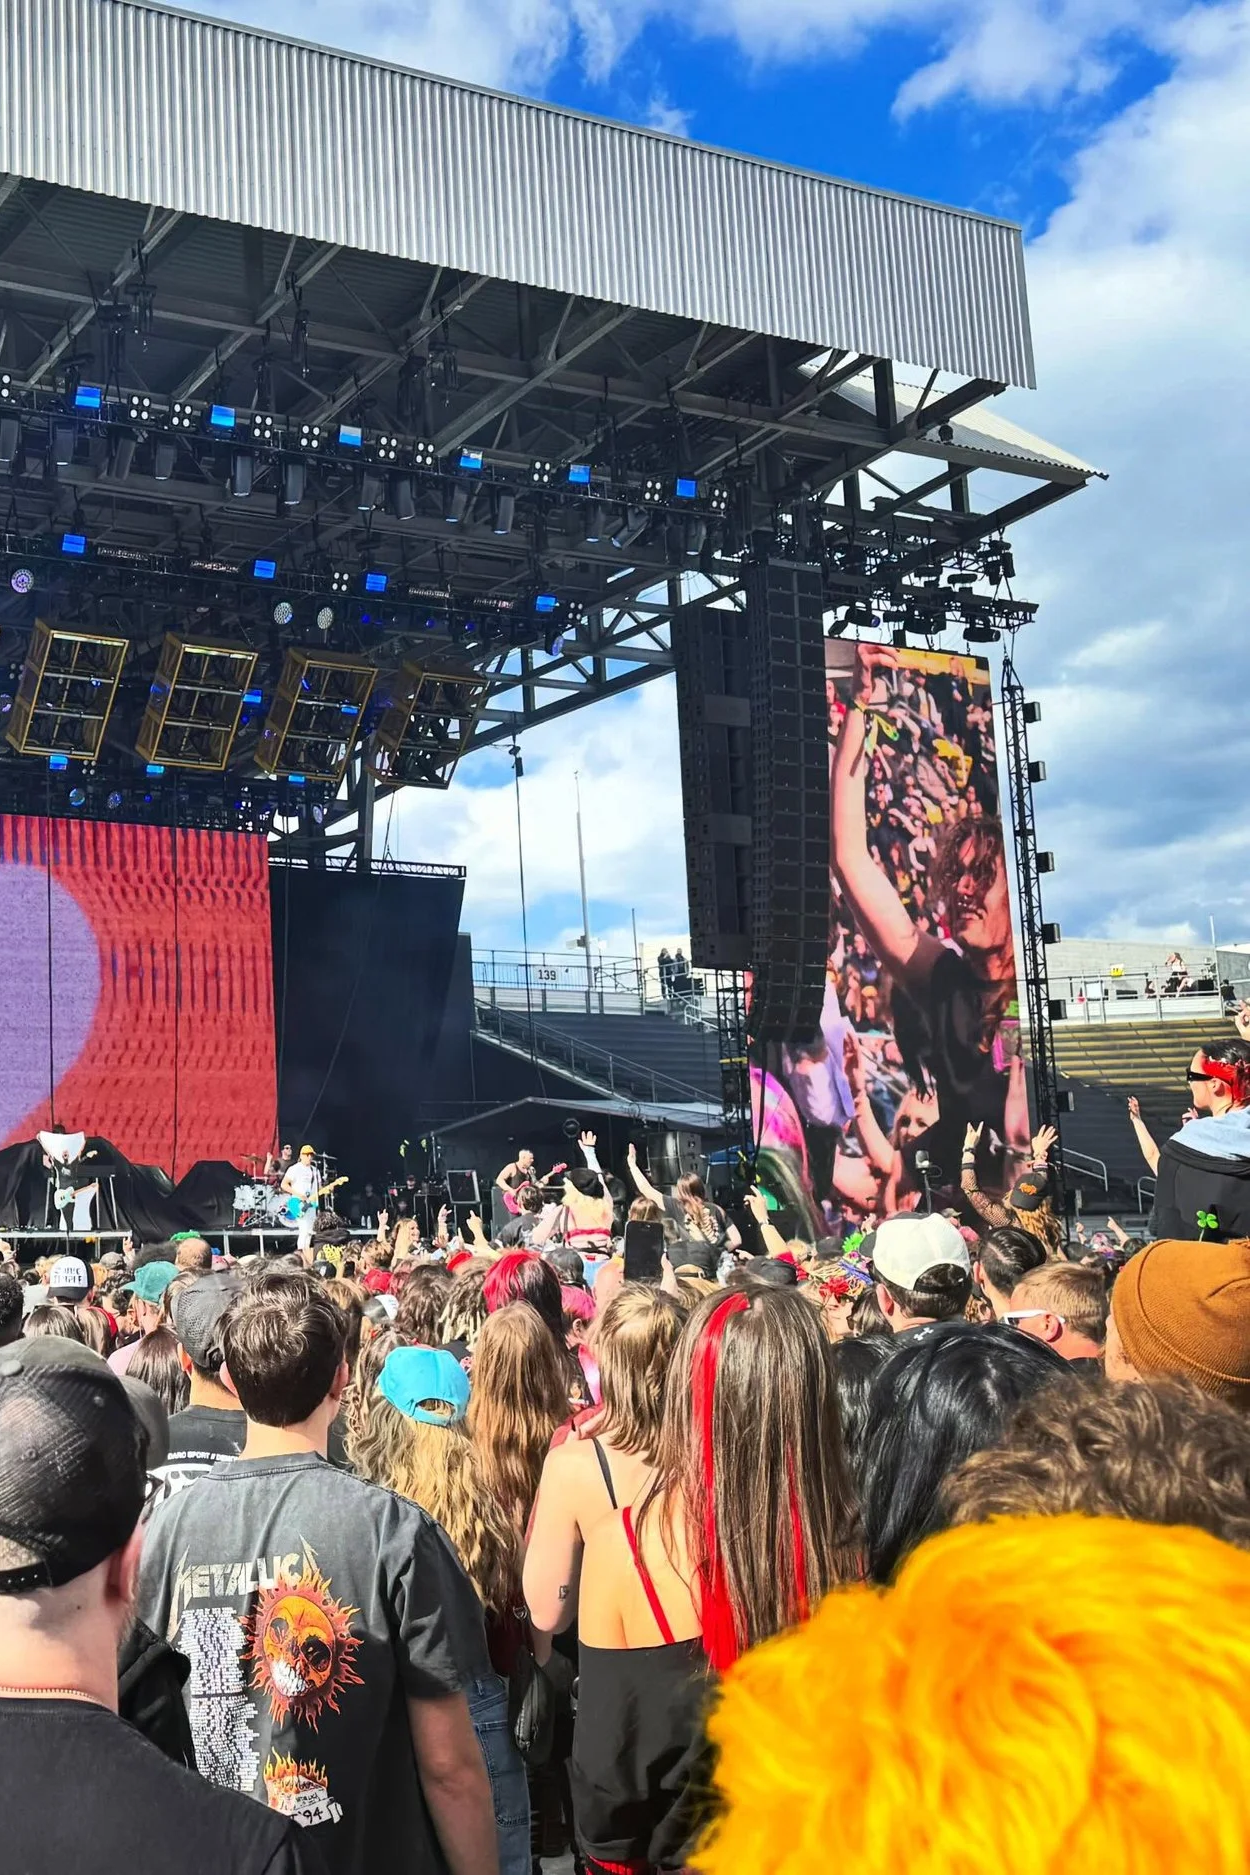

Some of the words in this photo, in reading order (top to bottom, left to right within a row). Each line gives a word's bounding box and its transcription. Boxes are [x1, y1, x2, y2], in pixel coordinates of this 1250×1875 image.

[538, 969, 557, 981] 139
[187, 1451, 210, 1460] SPORT
[166, 1534, 335, 1642] METALLICA
